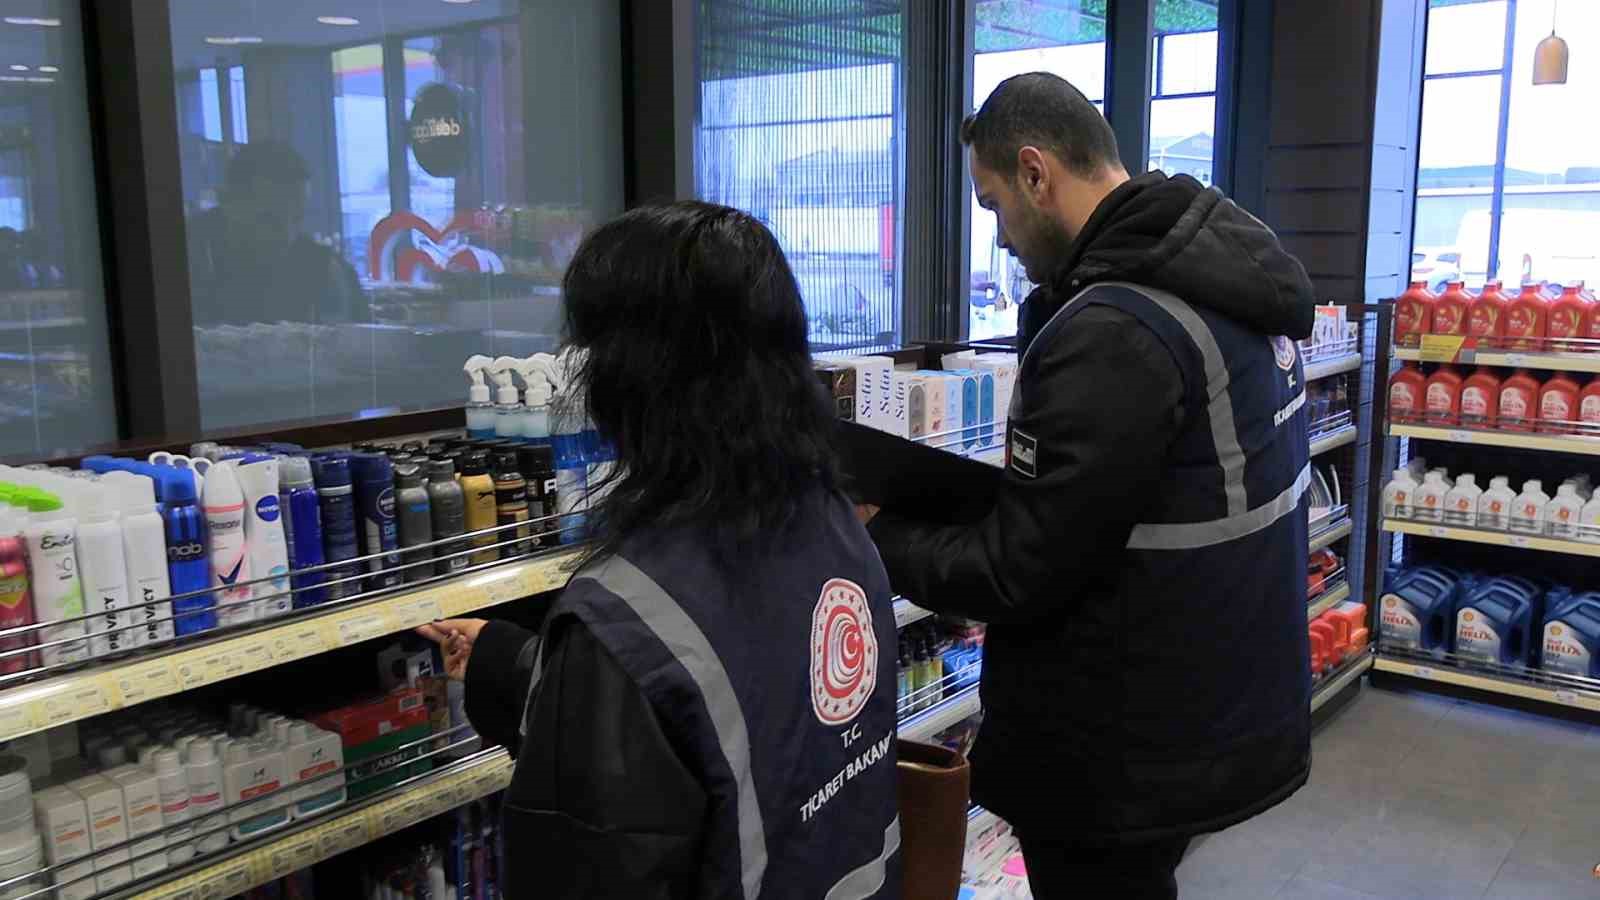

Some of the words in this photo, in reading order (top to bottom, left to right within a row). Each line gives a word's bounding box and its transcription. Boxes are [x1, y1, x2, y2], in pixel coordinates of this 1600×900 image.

[861, 372, 872, 418] Selin
[880, 369, 890, 414] Selin
[895, 381, 905, 420] Selin
[104, 597, 121, 651] PRVACY
